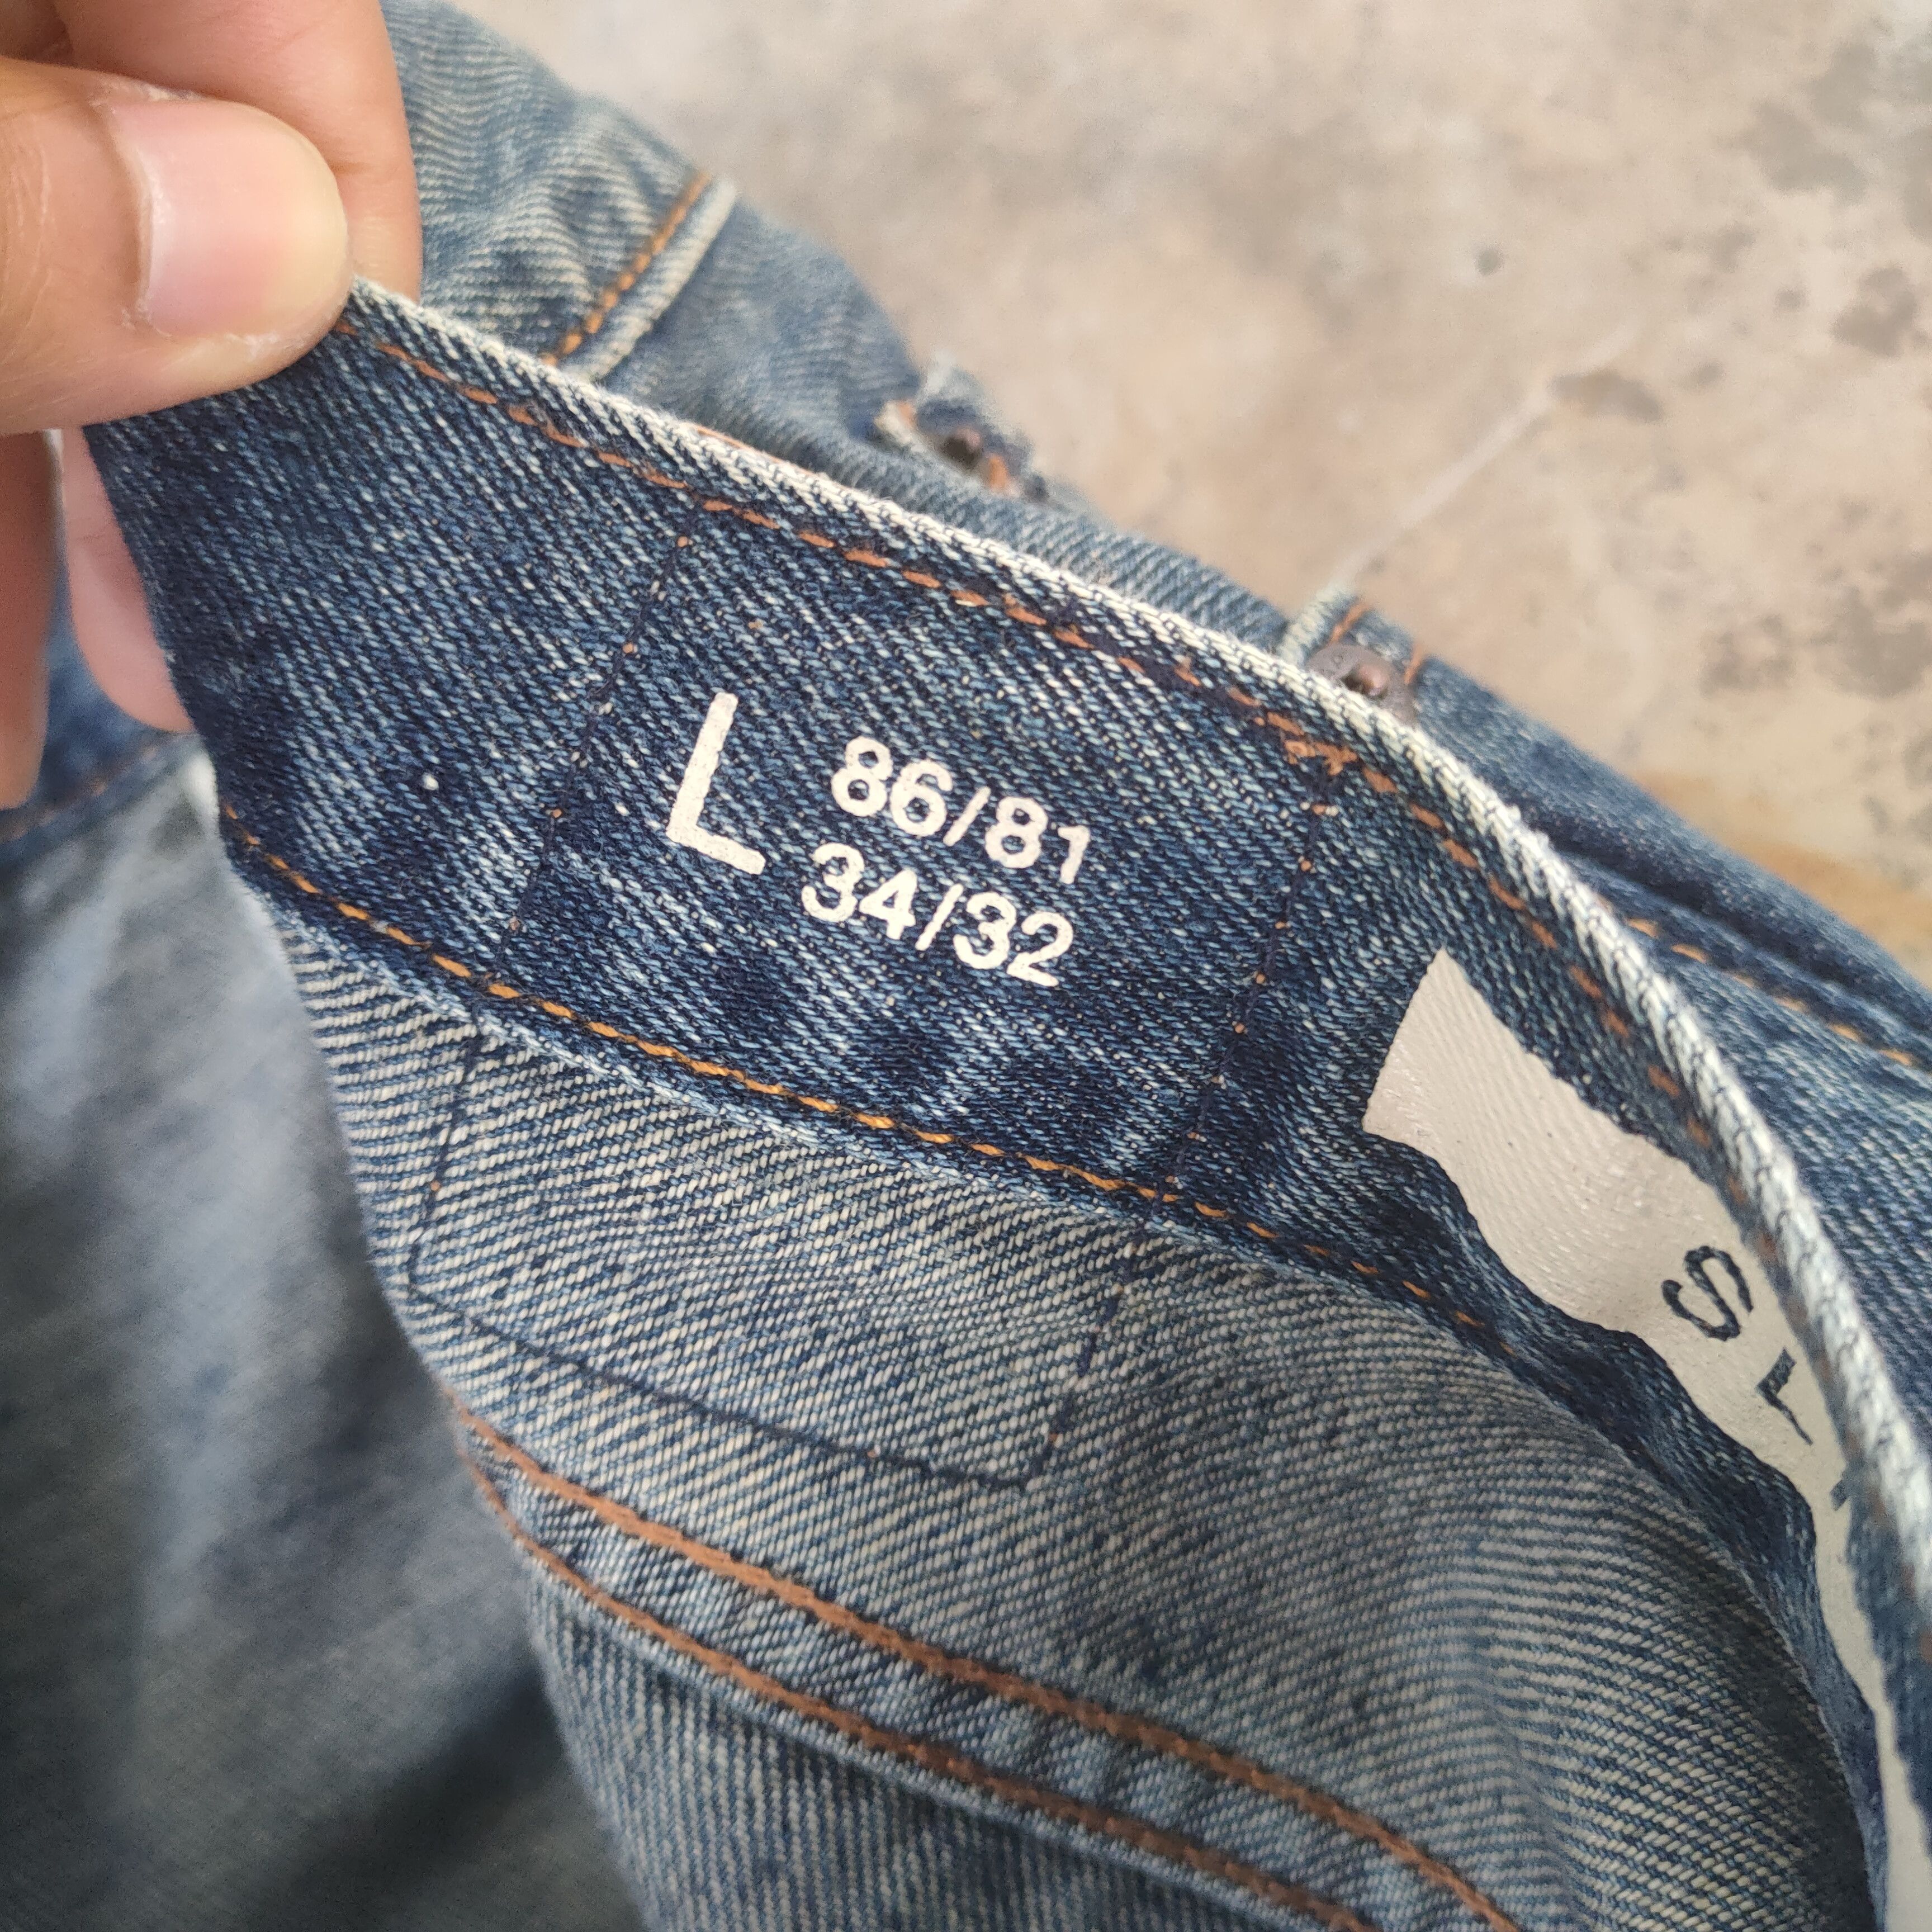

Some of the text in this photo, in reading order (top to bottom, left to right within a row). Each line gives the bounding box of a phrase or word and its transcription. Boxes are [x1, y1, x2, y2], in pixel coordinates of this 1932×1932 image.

[666, 692, 766, 874] L
[831, 736, 1090, 884] 86/81
[802, 842, 1073, 987] 34/32
